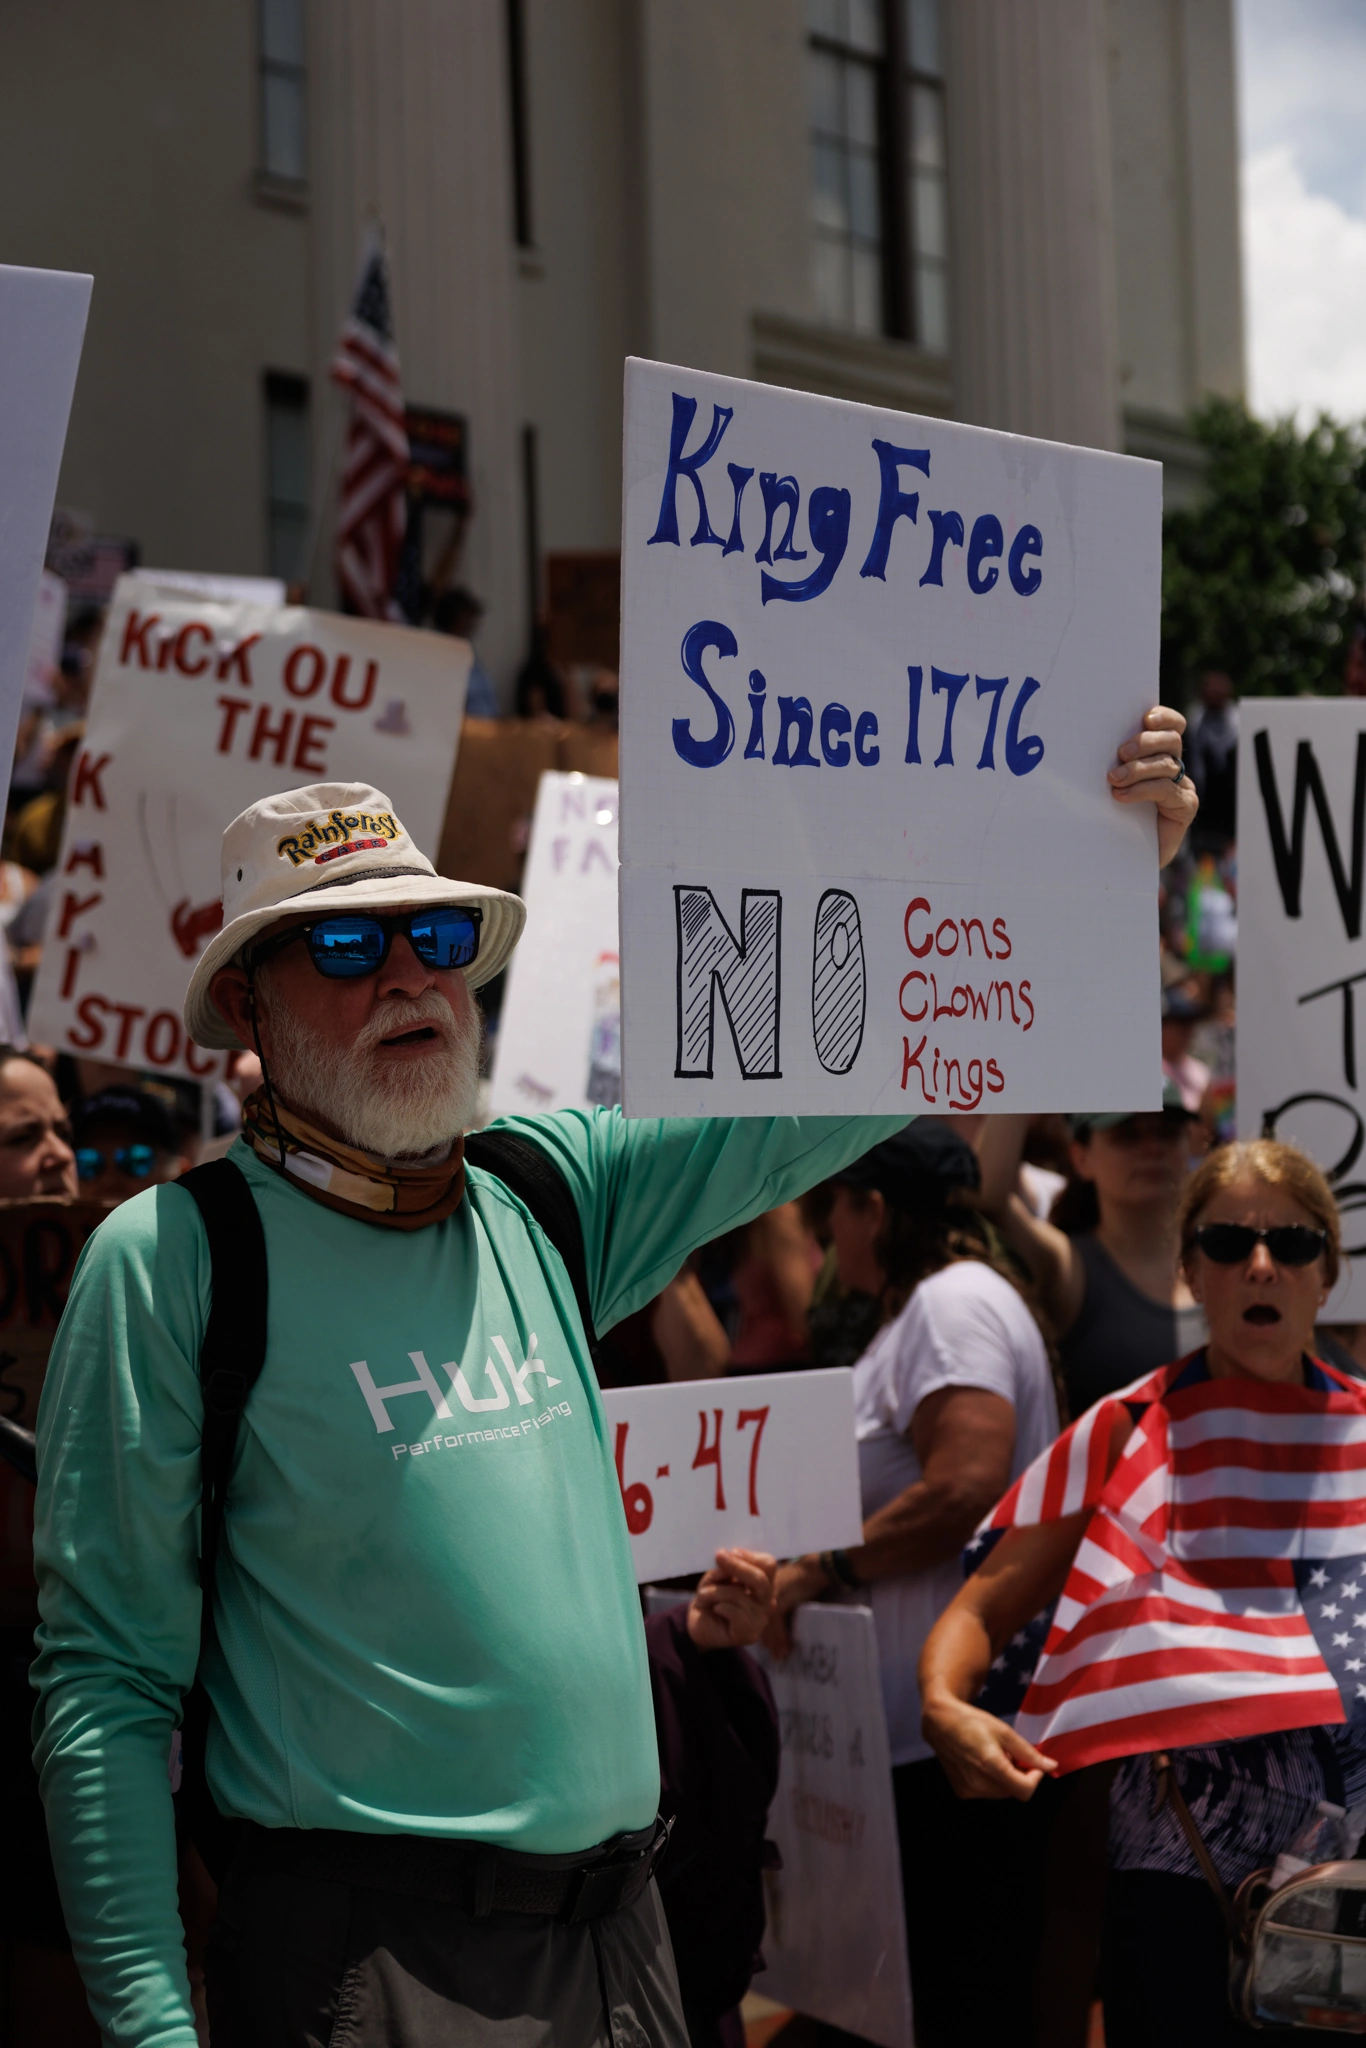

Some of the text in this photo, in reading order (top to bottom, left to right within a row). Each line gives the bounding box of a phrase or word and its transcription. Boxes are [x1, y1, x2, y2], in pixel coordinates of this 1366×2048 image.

[647, 392, 851, 606] King
[860, 438, 1043, 597] Free
[217, 696, 336, 776] THE
[672, 620, 1044, 776] Since 1776
[277, 811, 401, 866] Rainforest
[903, 897, 1013, 960] Cons
[673, 885, 866, 1080] NO
[900, 1035, 1006, 1112] Kings
[391, 1425, 520, 1460] Performance
